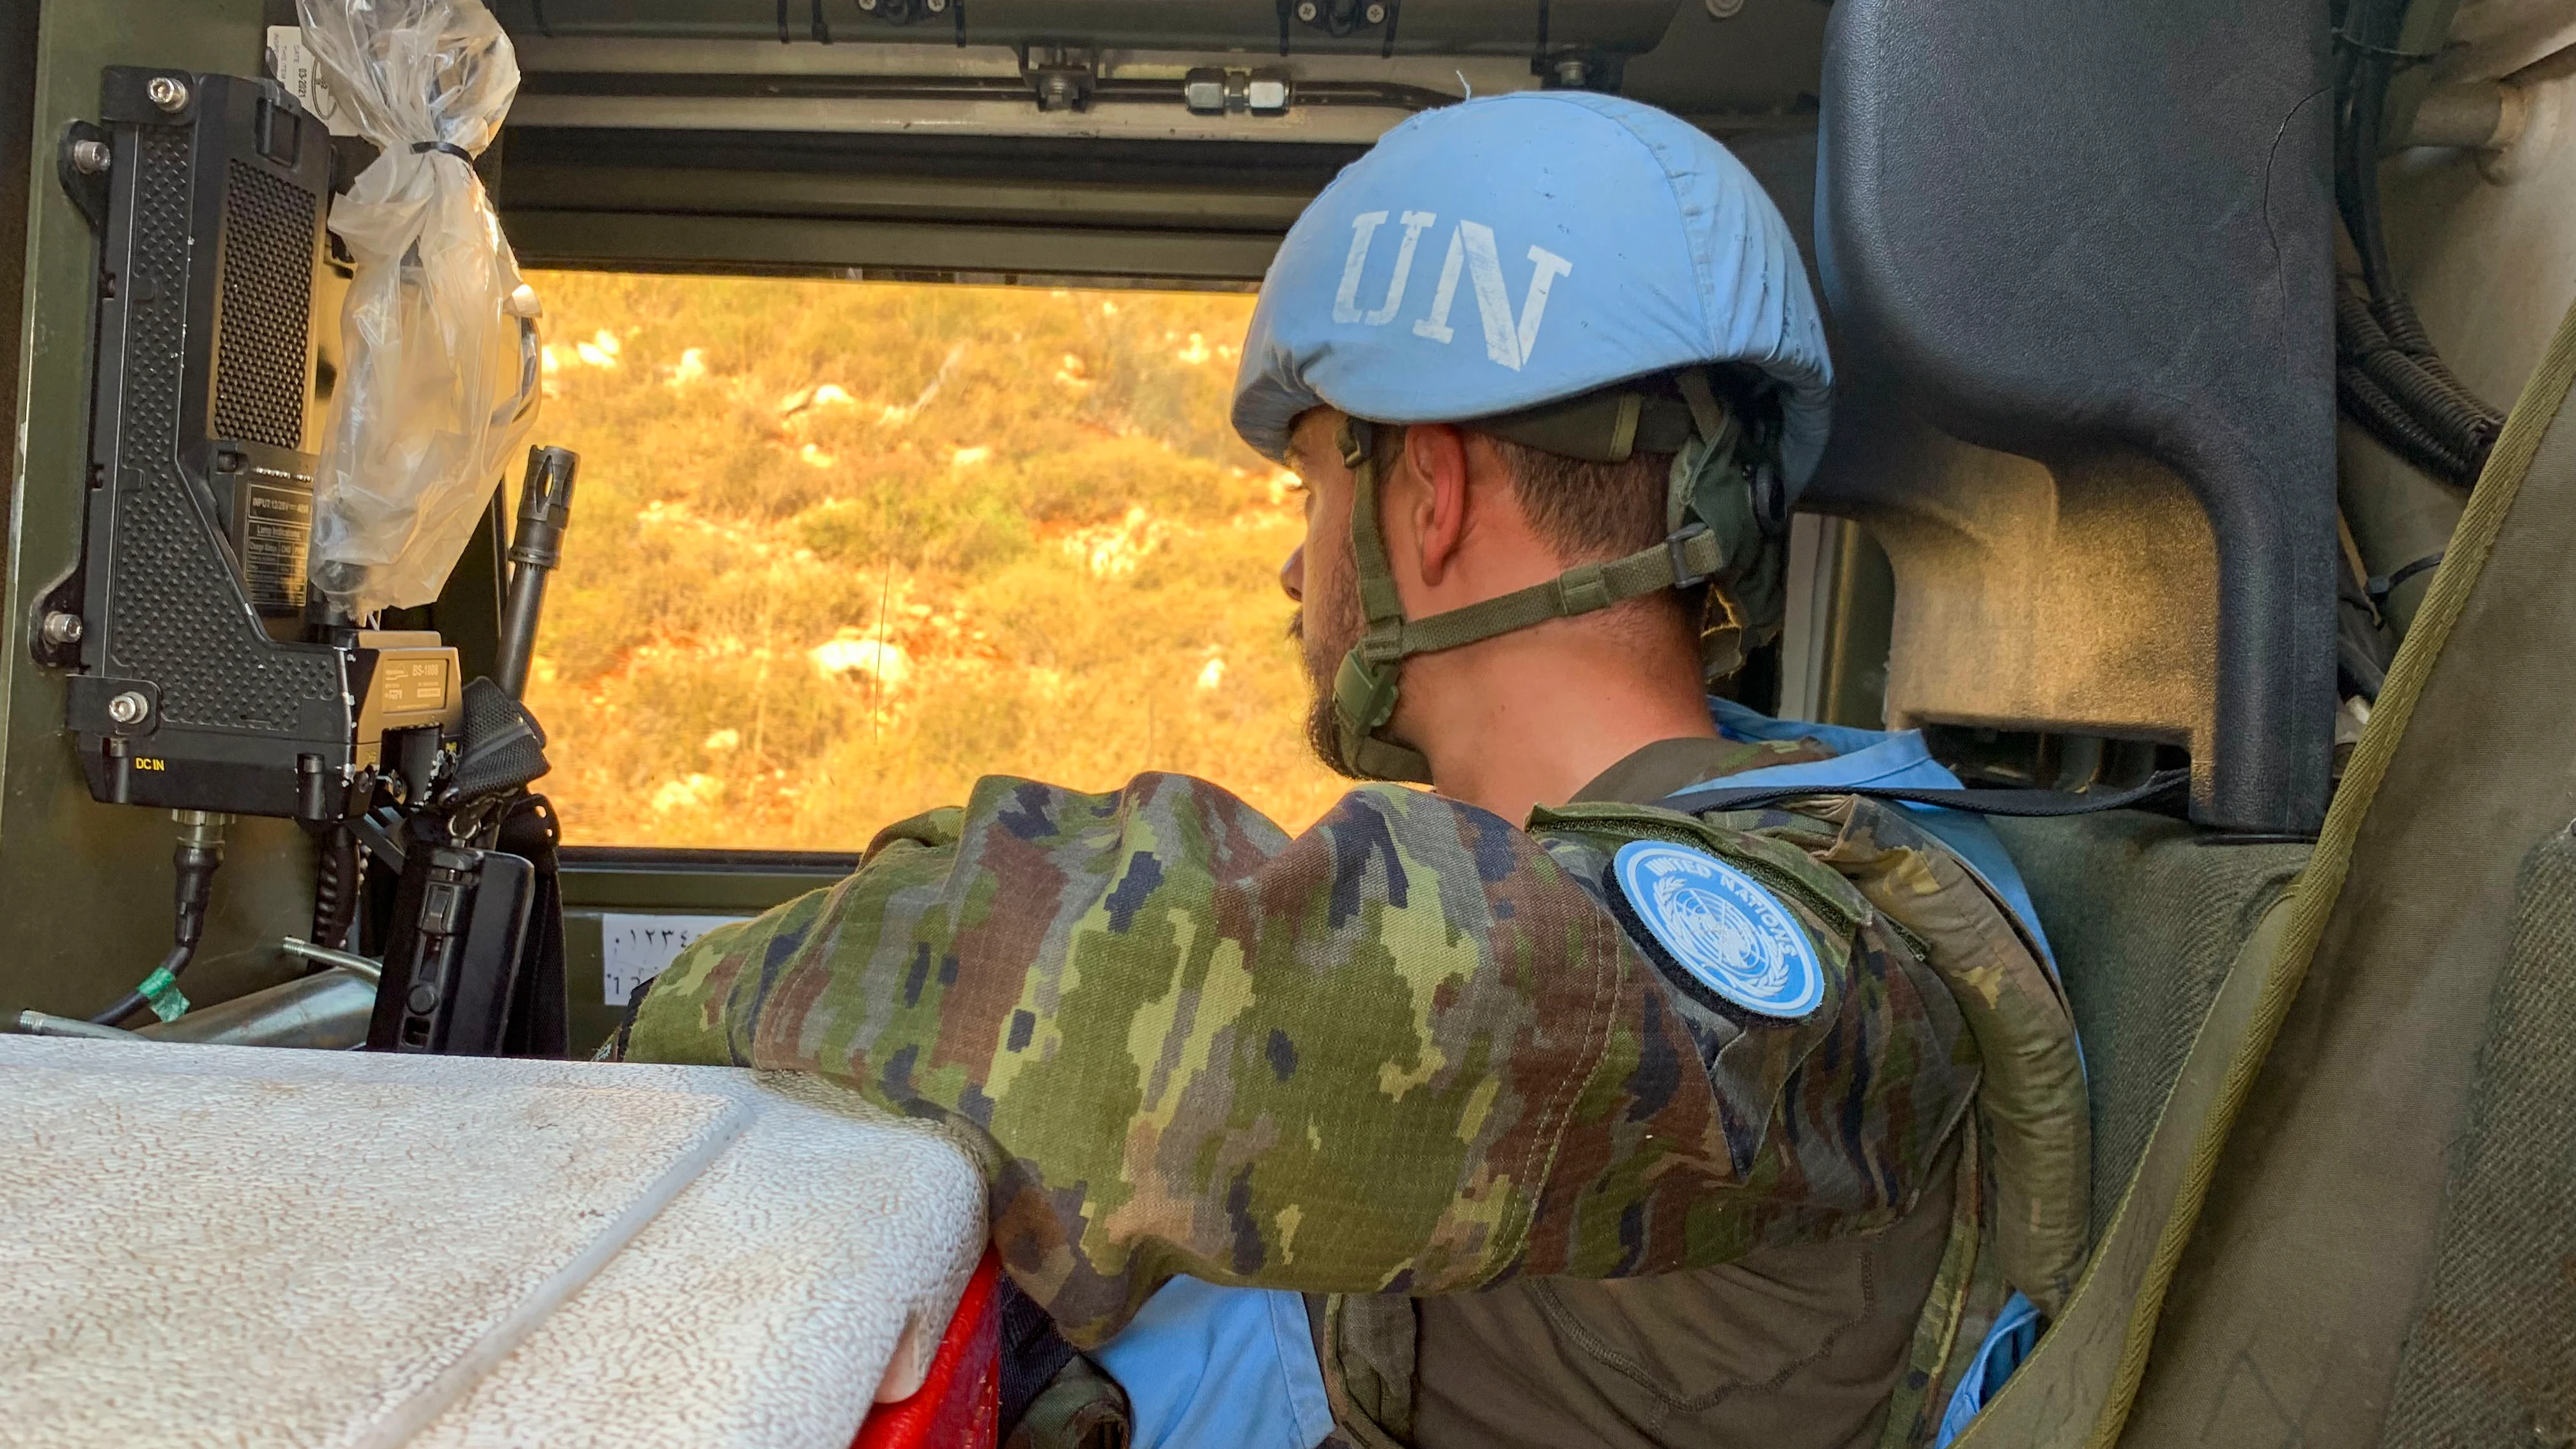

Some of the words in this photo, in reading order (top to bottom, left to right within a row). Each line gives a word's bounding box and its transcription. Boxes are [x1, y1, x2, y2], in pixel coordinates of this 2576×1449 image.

[298, 68, 307, 97] 03-2021
[1332, 210, 1573, 372] UN
[135, 757, 151, 770] DC
[153, 759, 165, 771] IN
[1644, 857, 1712, 879] UNITED
[1720, 874, 1798, 957] NATIONS
